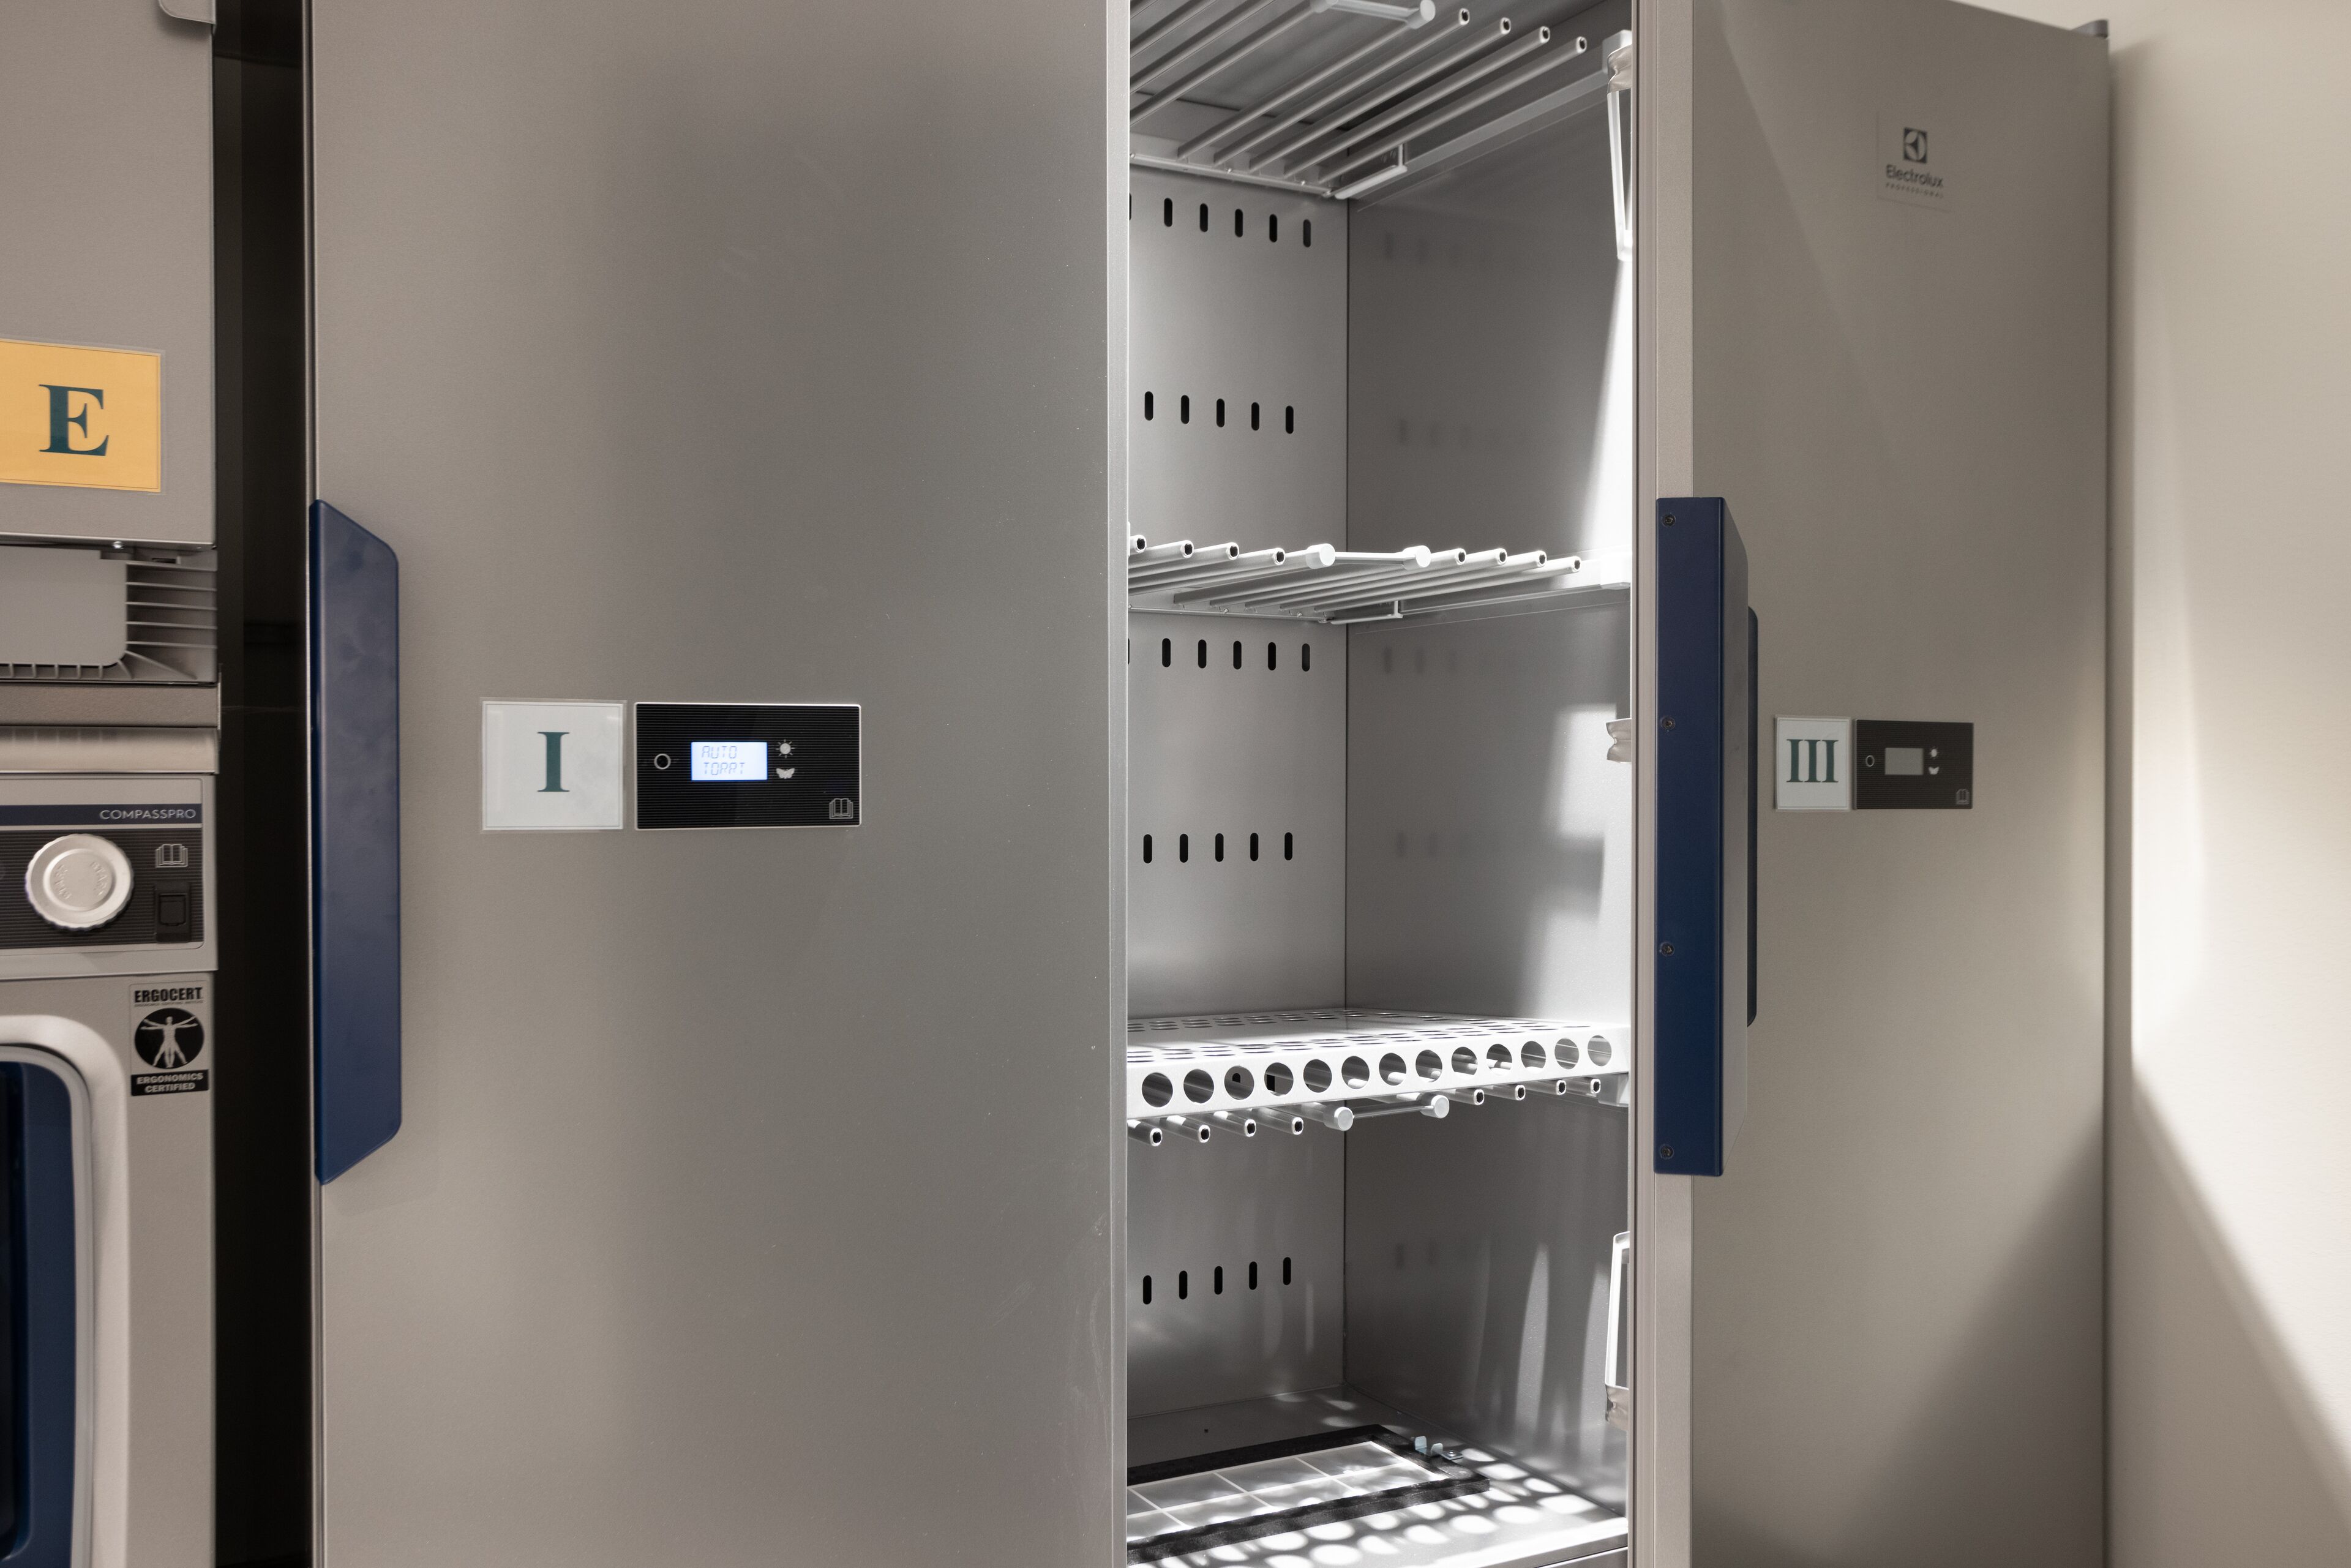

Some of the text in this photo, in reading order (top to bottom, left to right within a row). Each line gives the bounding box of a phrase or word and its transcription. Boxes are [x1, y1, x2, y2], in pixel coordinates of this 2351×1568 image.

[1886, 164, 1944, 189] Electrolux
[38, 383, 110, 456] E
[701, 746, 738, 759] AUTO
[1786, 738, 1839, 783] III
[536, 731, 571, 793] I
[99, 809, 197, 820] COMPASSPRO
[134, 986, 203, 1003] ERGOCERT
[136, 1072, 204, 1085] ERGONOMICS
[144, 1082, 196, 1094] CERTIFIED
